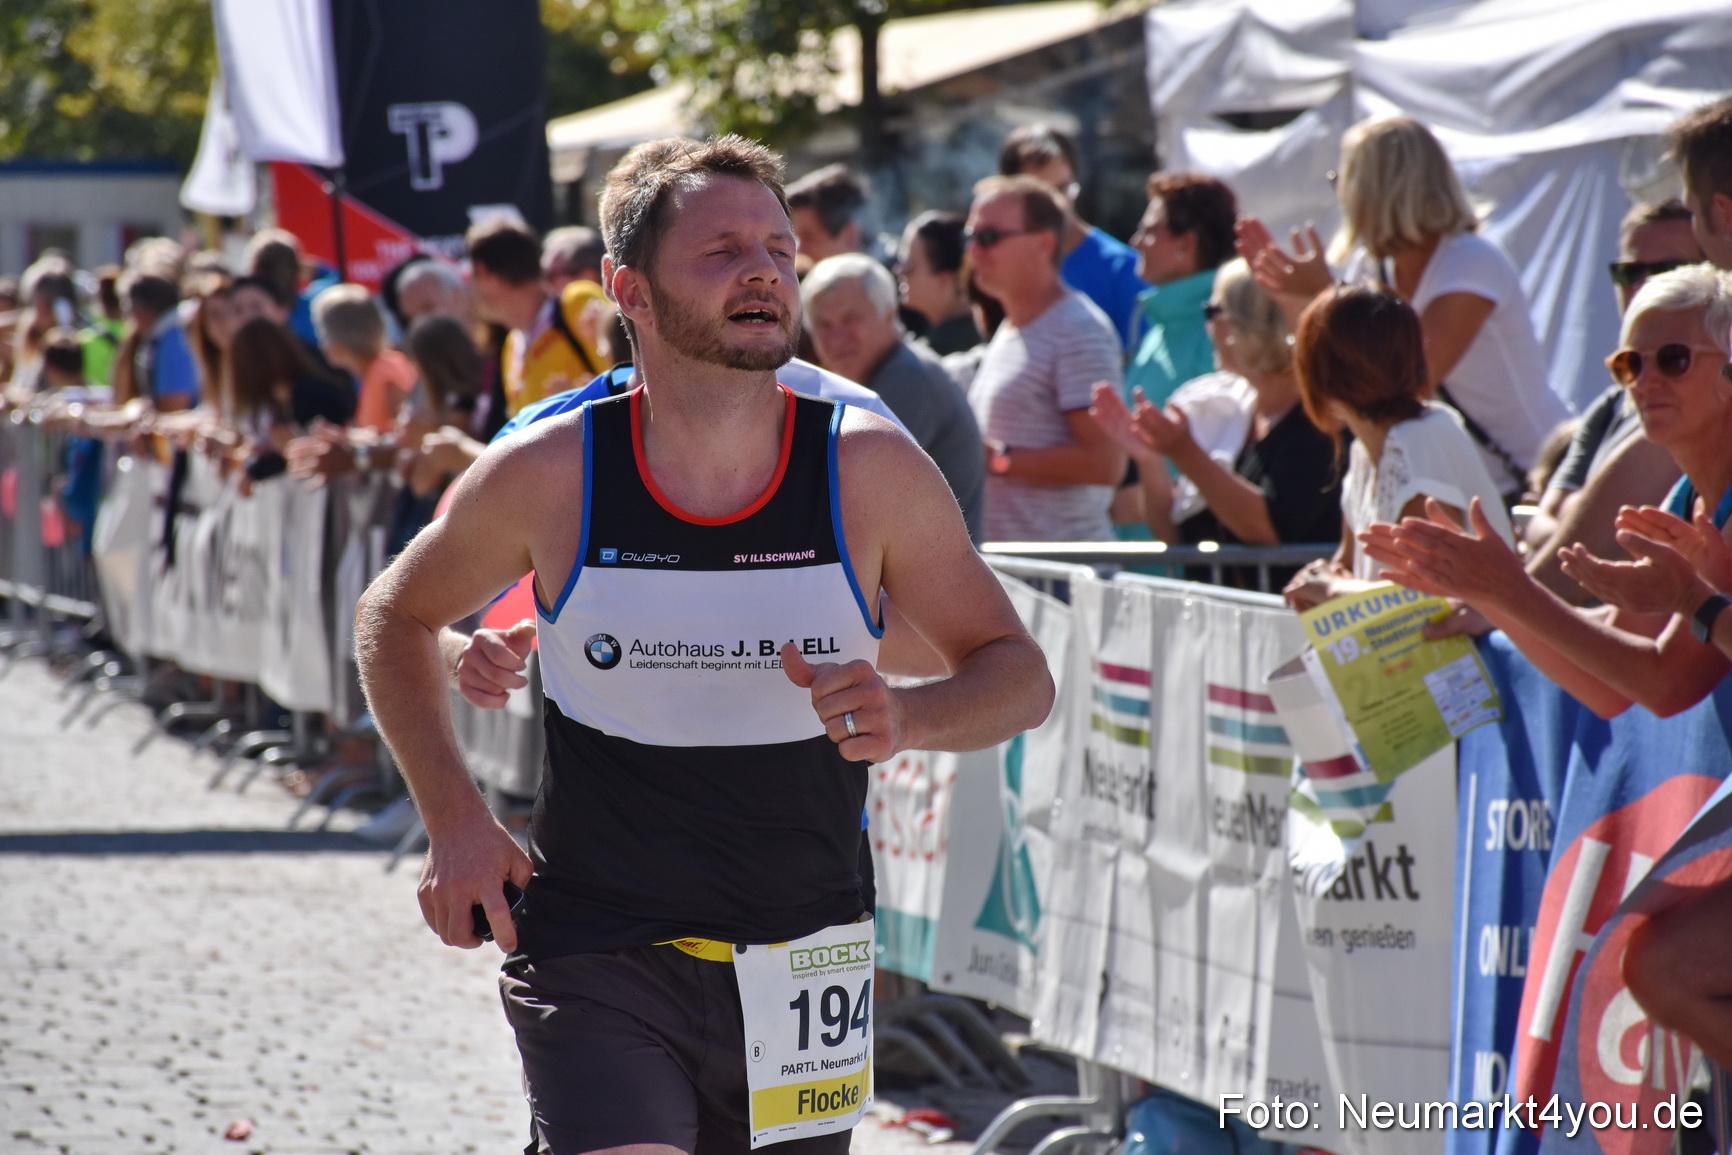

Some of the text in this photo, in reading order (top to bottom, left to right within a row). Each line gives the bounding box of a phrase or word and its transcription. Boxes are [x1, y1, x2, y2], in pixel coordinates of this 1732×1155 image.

[733, 550, 816, 563] SV ILLSCHWANG
[587, 634, 618, 648] BMW
[629, 639, 725, 657] Autohaus
[731, 640, 751, 656] J.
[759, 640, 781, 656] B.
[1326, 635, 1370, 666] 19.
[630, 659, 699, 669] Leidenschaft
[701, 659, 741, 671] beginnt
[744, 660, 761, 669] mit
[1485, 799, 1551, 851] STORE
[790, 940, 871, 972] BOCK
[792, 970, 818, 980] inspired
[820, 969, 826, 977] by
[827, 966, 845, 975] smart
[789, 978, 872, 1051] 194
[754, 1046, 760, 1057] B
[781, 1061, 818, 1076] PARTL
[820, 1052, 863, 1071] Neumarkt
[798, 1083, 859, 1115] Flocke
